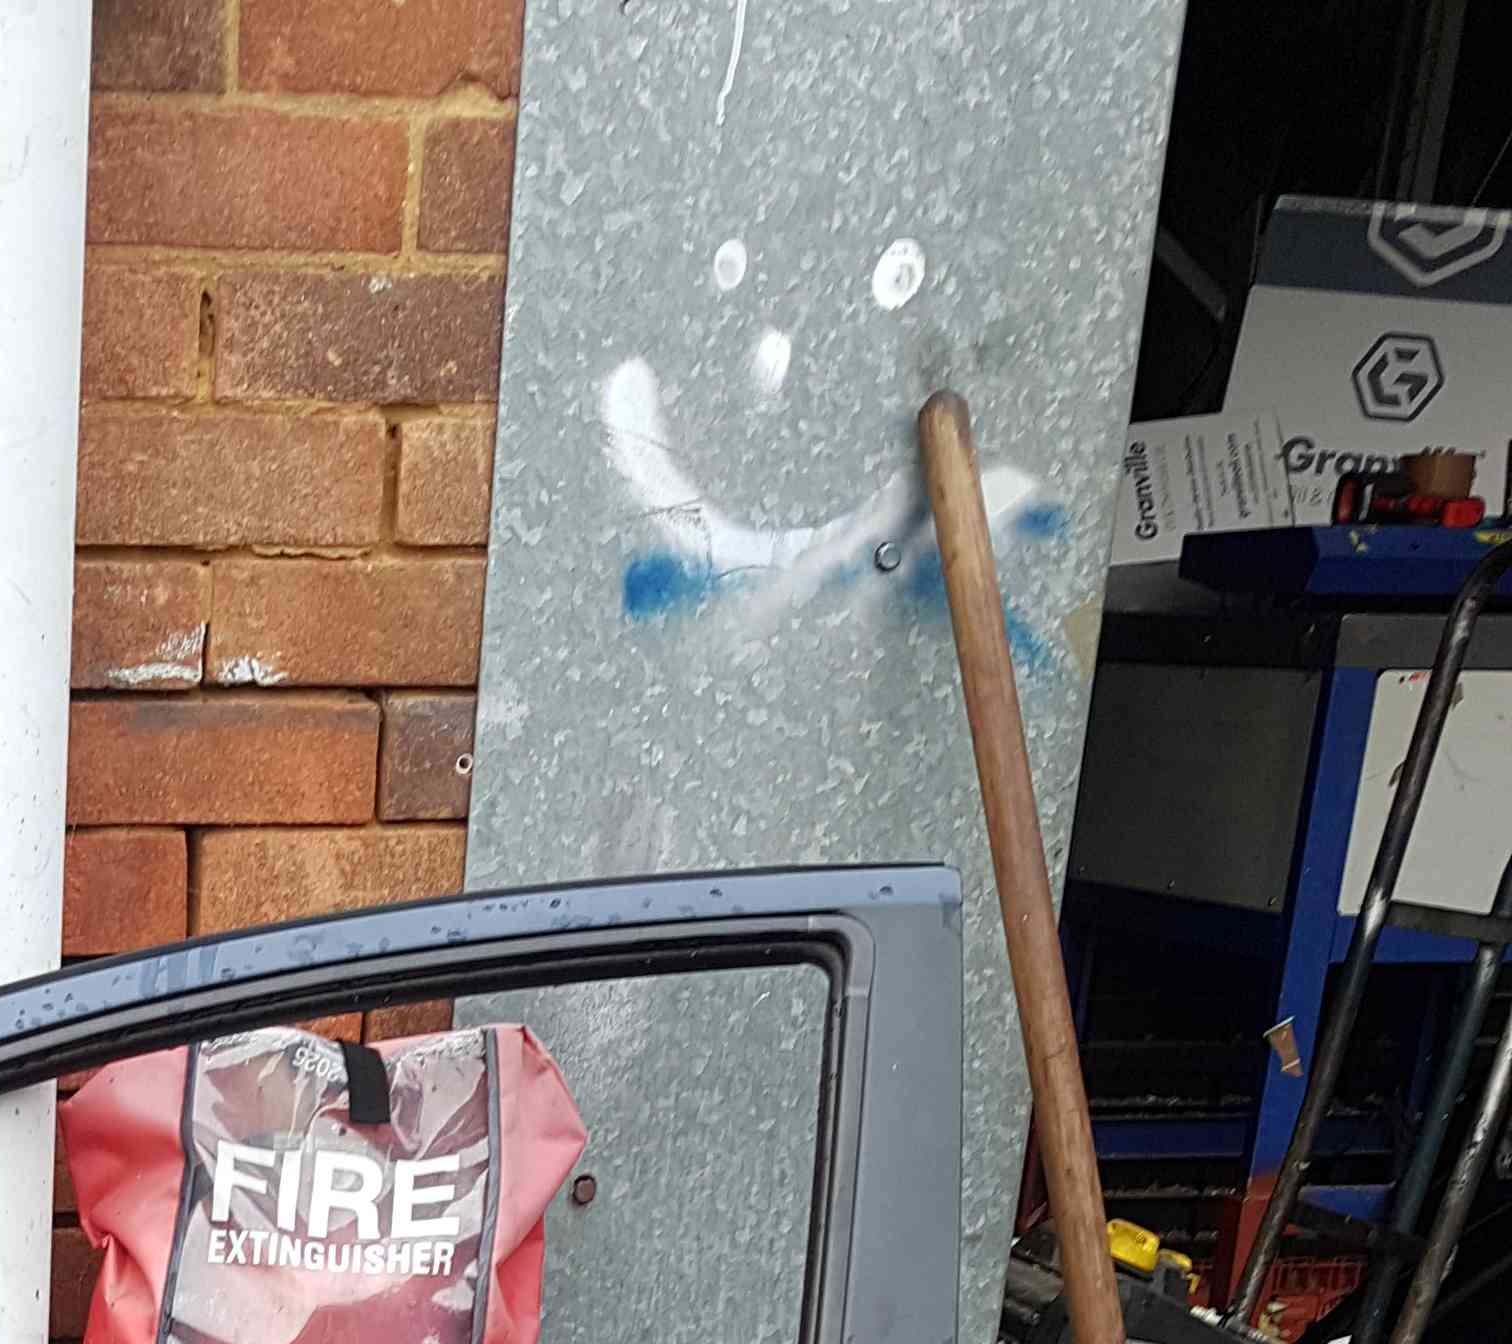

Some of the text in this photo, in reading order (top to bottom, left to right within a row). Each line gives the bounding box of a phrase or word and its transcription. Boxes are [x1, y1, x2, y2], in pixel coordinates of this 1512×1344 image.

[1123, 440, 1160, 541] Granville
[210, 1138, 462, 1241] FIRE
[206, 1229, 457, 1277] EXTINGUISHER
